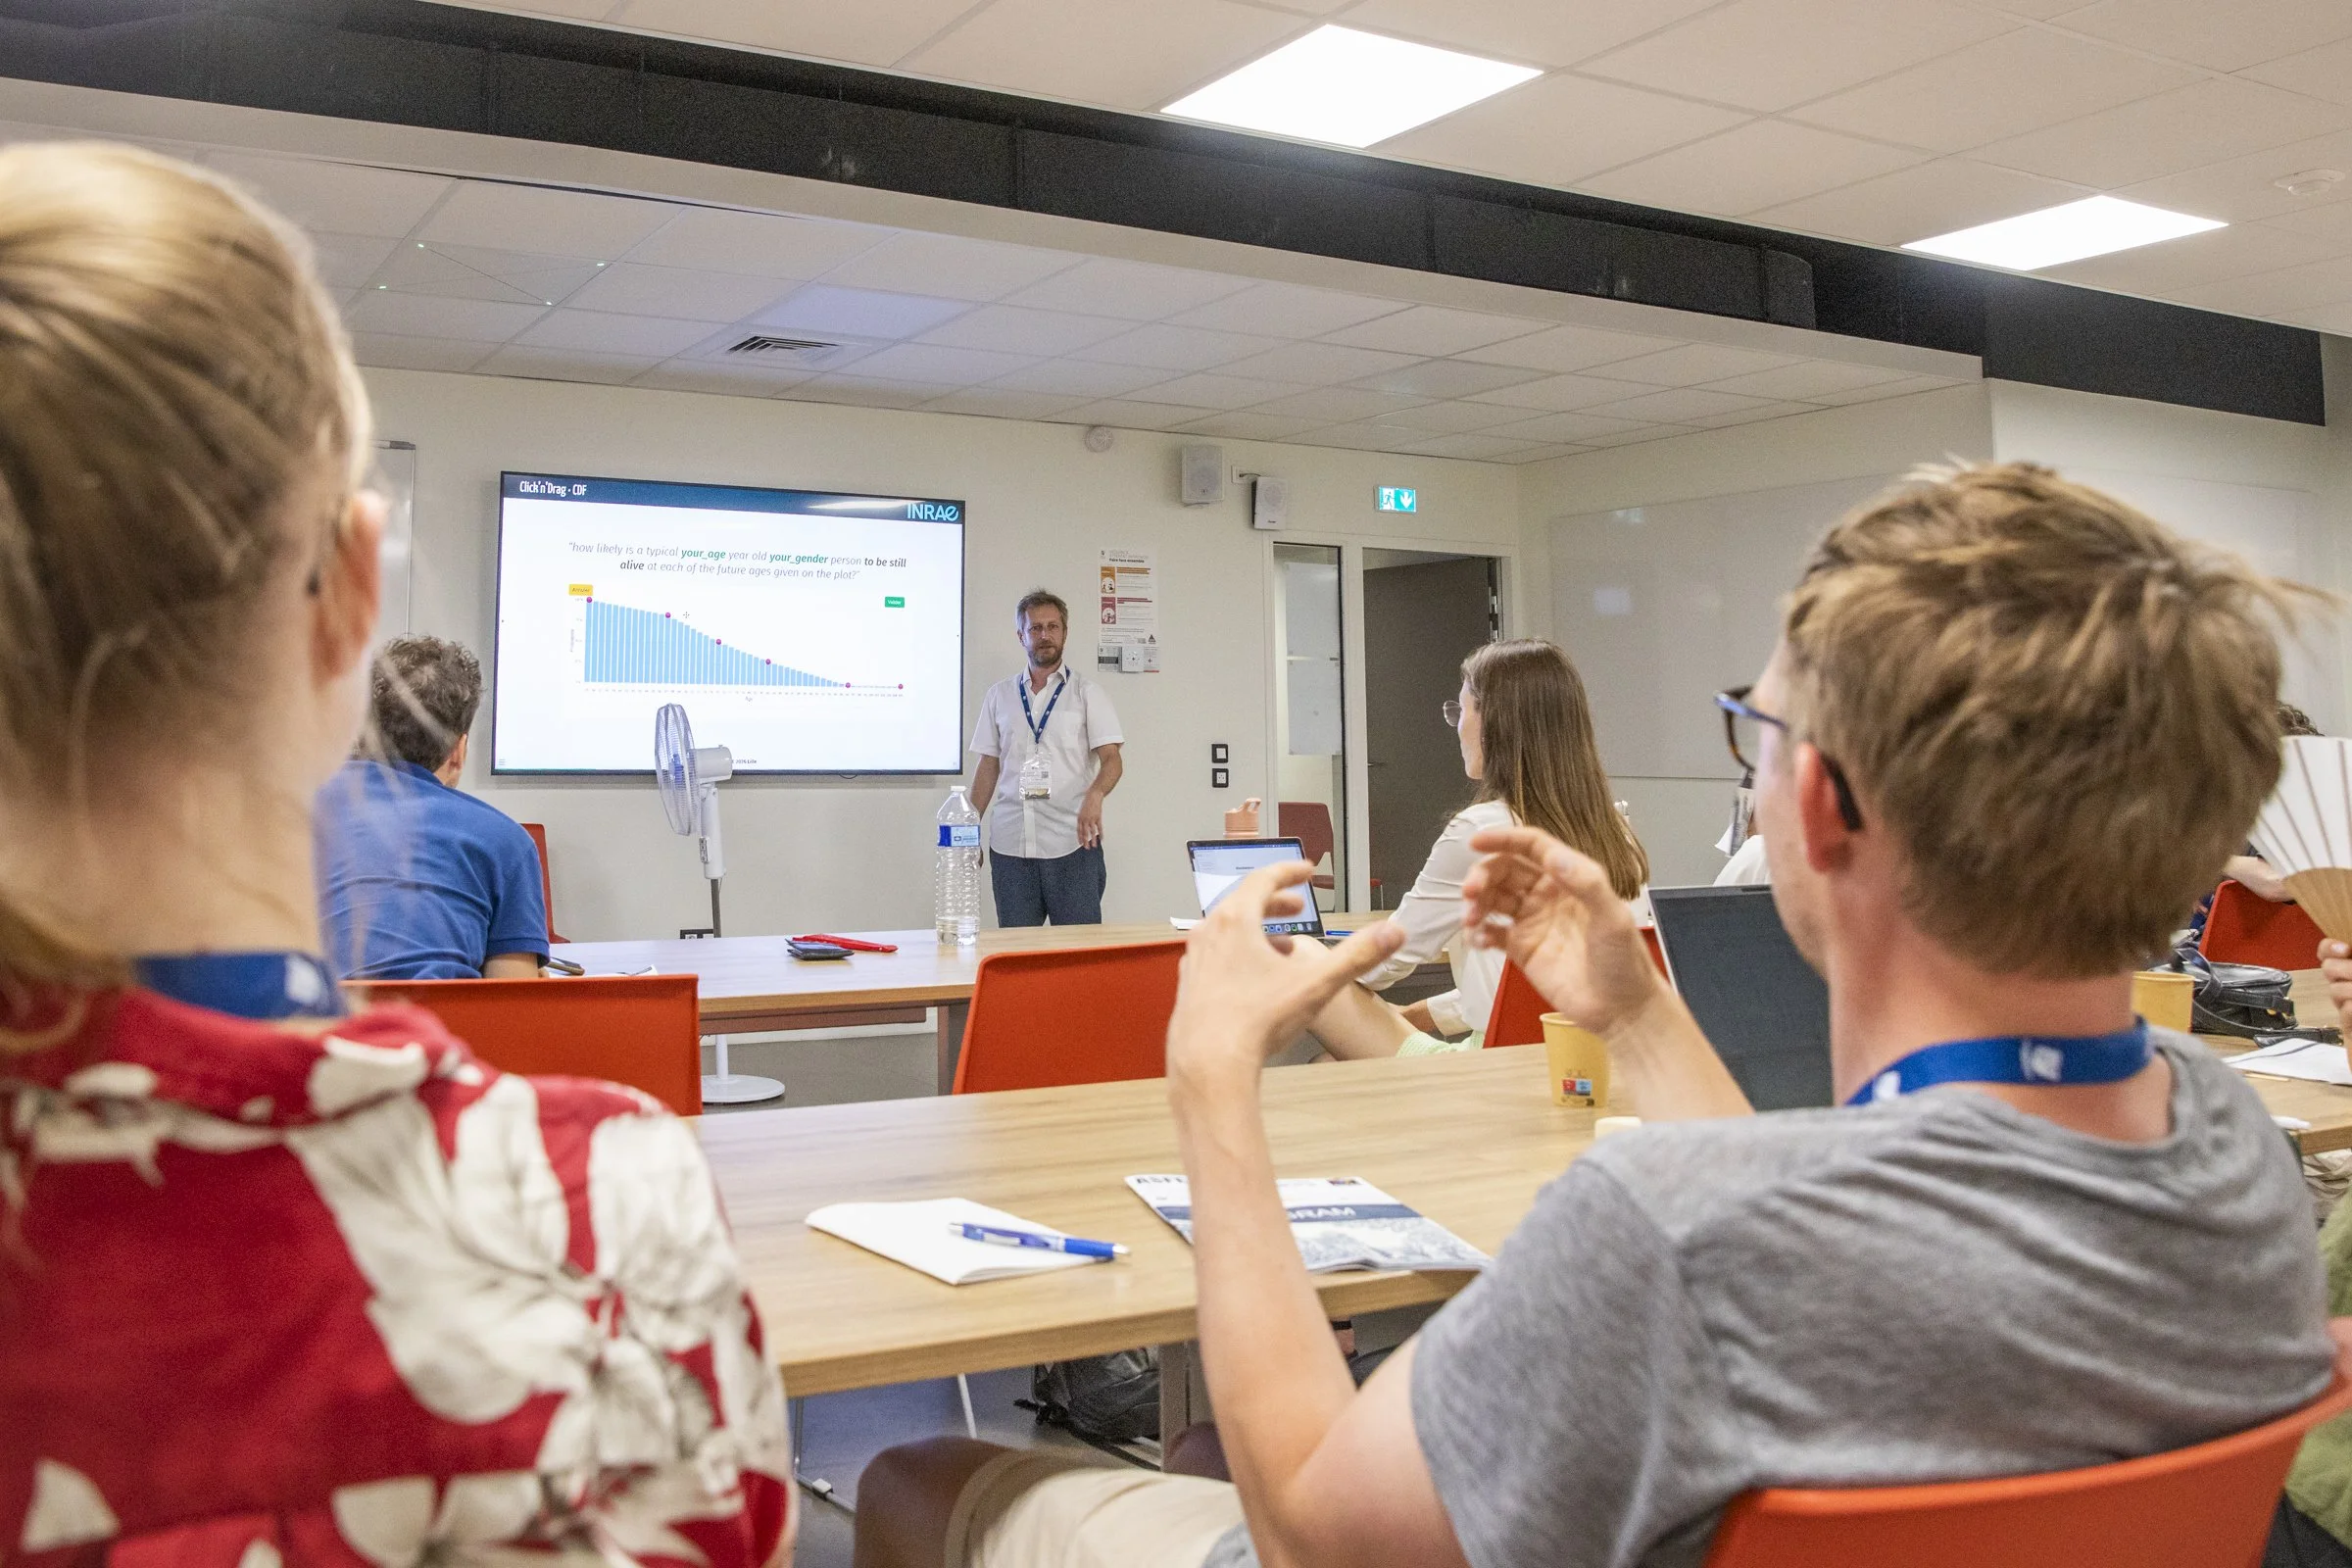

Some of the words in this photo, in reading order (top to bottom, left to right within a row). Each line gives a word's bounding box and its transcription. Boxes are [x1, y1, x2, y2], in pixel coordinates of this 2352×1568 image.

[572, 484, 587, 496] CDF
[597, 543, 623, 556] likely
[626, 546, 634, 555] is
[637, 547, 643, 555] a
[646, 545, 679, 560] typical
[681, 548, 726, 560] your_age
[729, 551, 749, 562] year
[752, 551, 768, 561] old
[769, 552, 829, 565] your_gender
[831, 556, 861, 567] person
[864, 557, 874, 566] to
[876, 557, 887, 567] be
[889, 557, 906, 568] still
[620, 560, 644, 570] alive
[647, 562, 657, 571] at
[660, 562, 684, 572] each
[686, 563, 697, 574] of
[699, 563, 715, 573] the
[717, 564, 746, 576] future
[749, 567, 771, 578] ages
[774, 567, 799, 579] given
[802, 569, 814, 578] on
[816, 568, 831, 579] the
